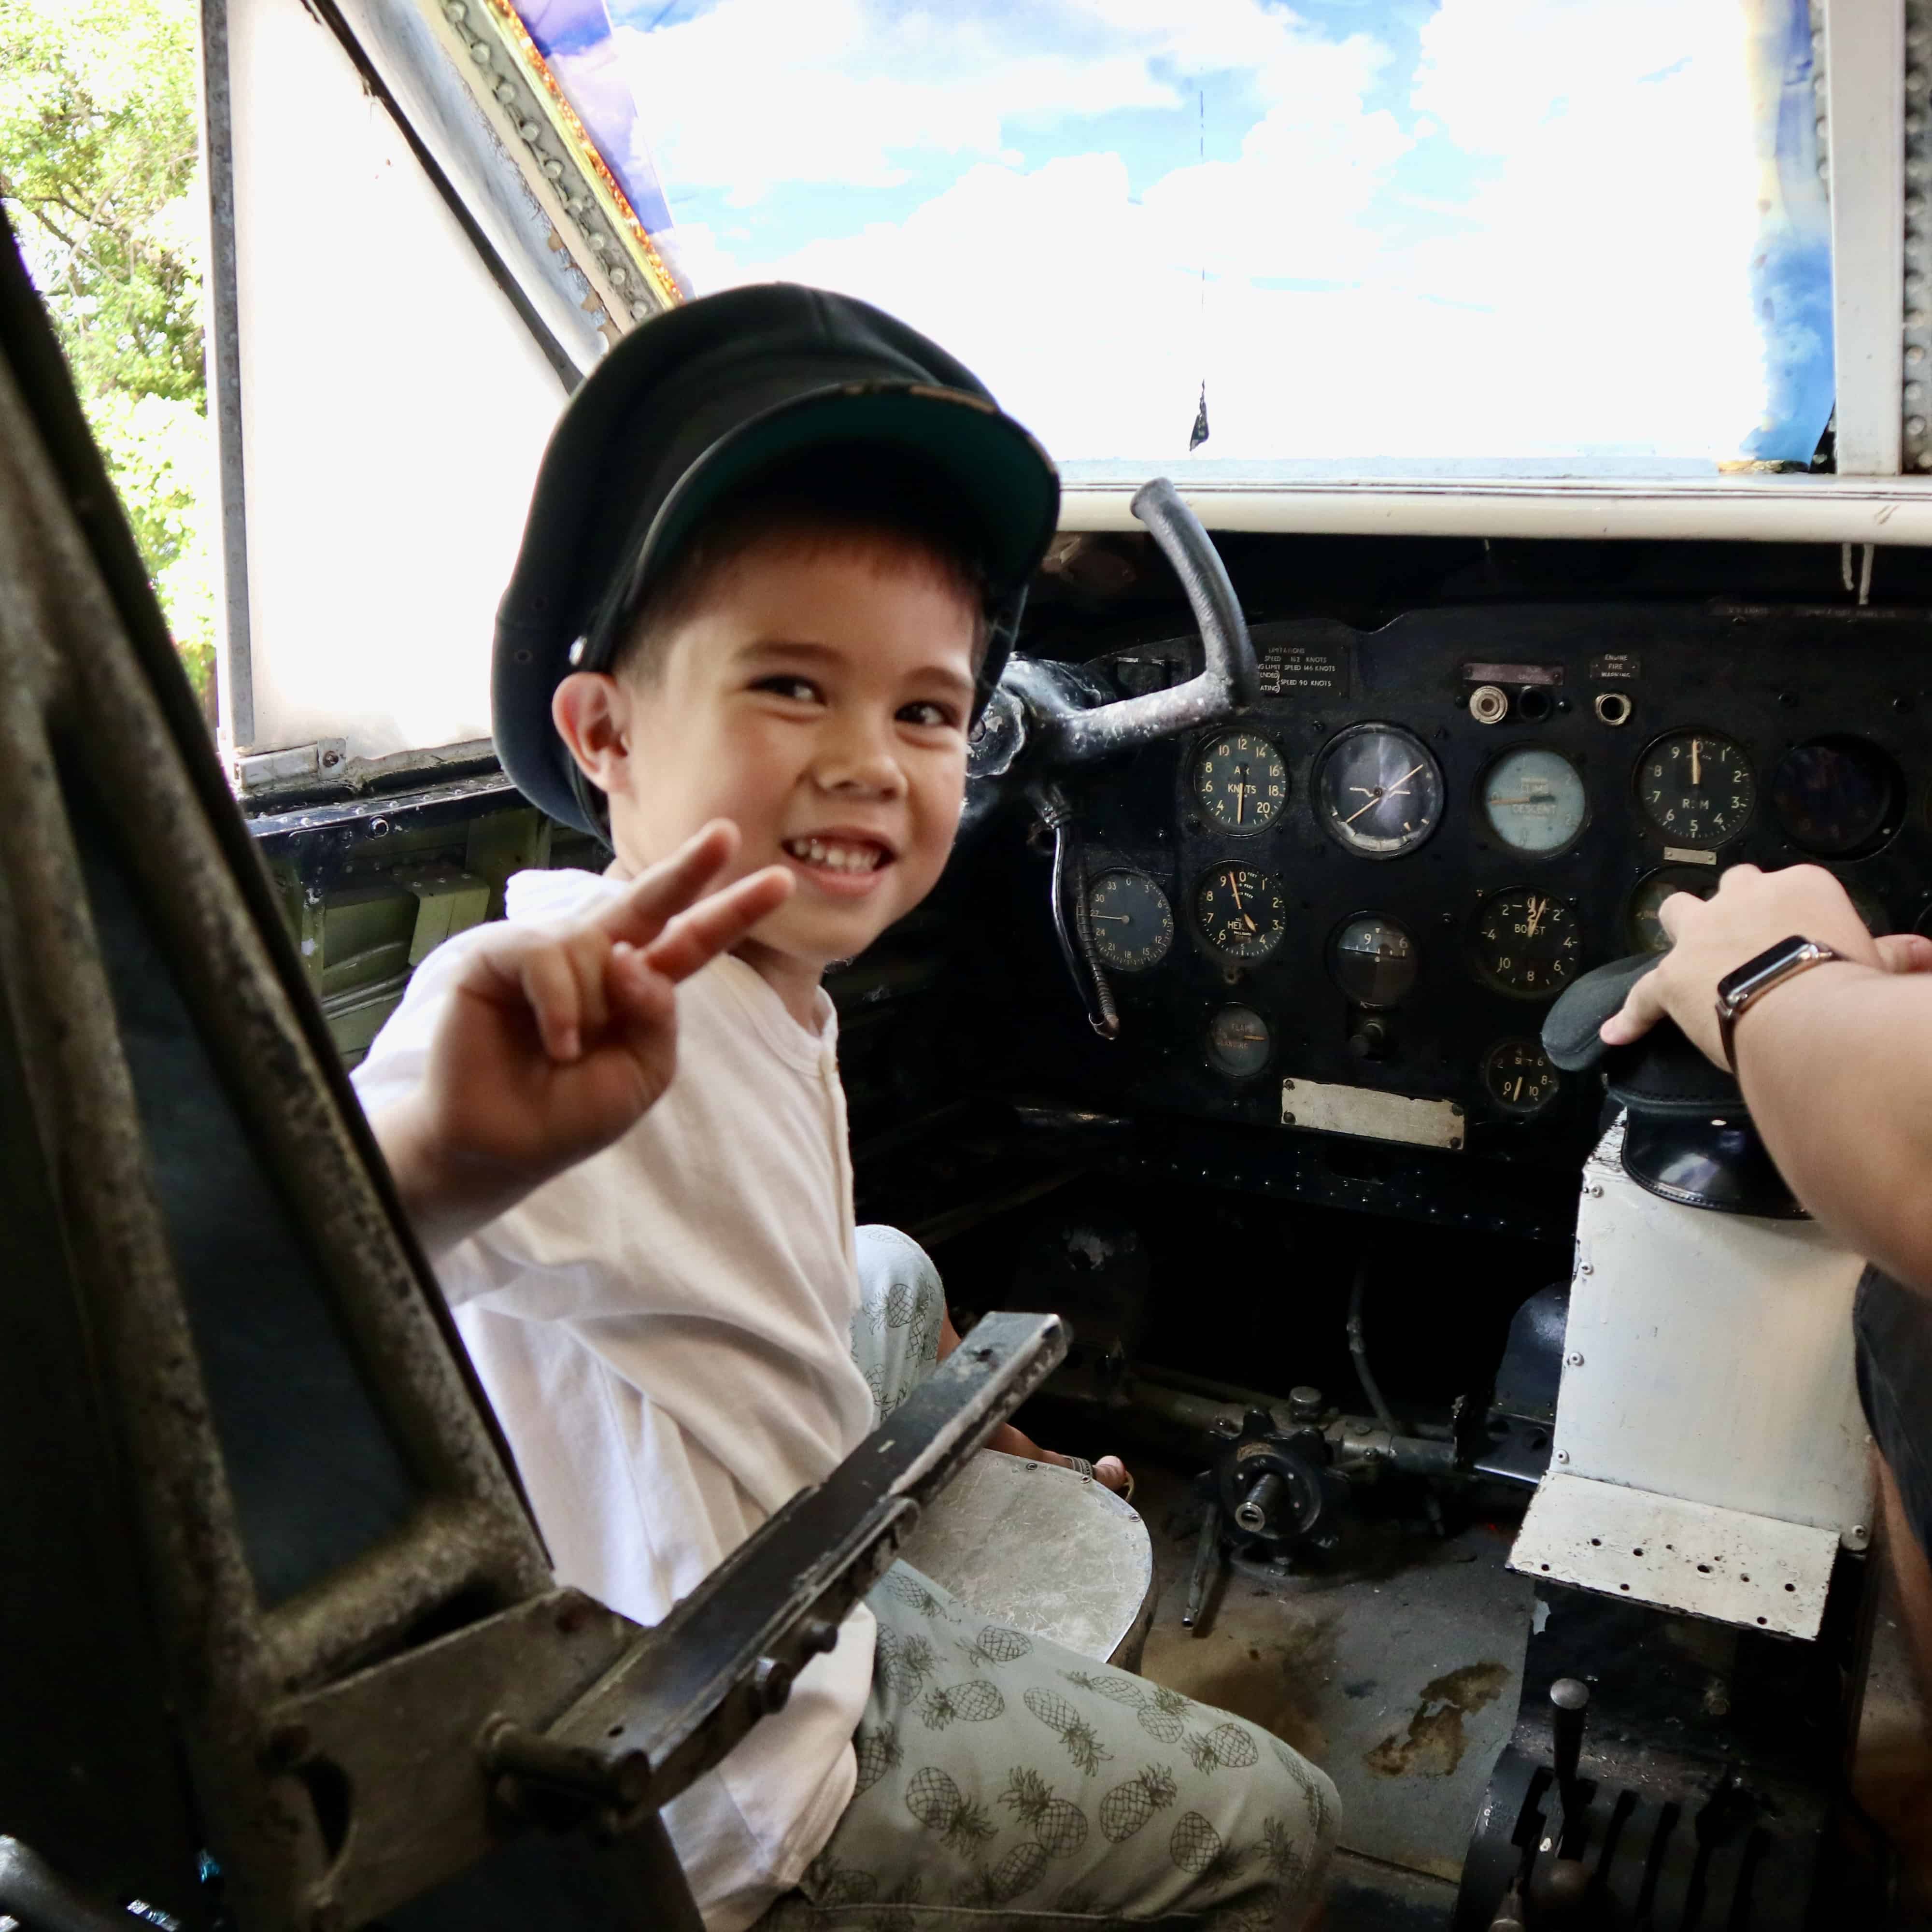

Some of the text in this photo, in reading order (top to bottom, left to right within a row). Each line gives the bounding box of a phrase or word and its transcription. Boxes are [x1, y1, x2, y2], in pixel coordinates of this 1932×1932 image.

[1219, 744, 1230, 756] 10
[1237, 738, 1248, 750] 12
[1256, 747, 1266, 758] 14
[1671, 746, 1680, 759] 9
[1205, 761, 1213, 773] 8
[1269, 765, 1280, 777] 16
[1653, 765, 1662, 777] 8
[1733, 770, 1742, 782] 2
[1205, 781, 1213, 793] 6
[1268, 785, 1279, 796] 18
[1652, 790, 1661, 803] 7
[1731, 796, 1740, 809] 3
[1216, 799, 1224, 811] 4
[1256, 801, 1271, 813] 20
[1666, 809, 1675, 822] 6
[1713, 812, 1724, 825] 4
[1690, 819, 1699, 832] 5
[1125, 877, 1132, 886] 0
[1220, 875, 1227, 887] 9
[1238, 871, 1247, 882] 0
[1107, 881, 1117, 890] 33
[1094, 894, 1106, 903] 30
[1206, 890, 1214, 902] 8
[1157, 899, 1163, 908] 6
[1272, 896, 1279, 909] 2
[1502, 904, 1509, 916] 2
[1553, 909, 1561, 921] 2
[1162, 919, 1167, 927] 9
[1207, 912, 1214, 923] 7
[1272, 919, 1279, 931] 3
[1514, 923, 1546, 935] BOST
[1095, 927, 1106, 936] 24
[1219, 929, 1227, 941] 6
[1487, 928, 1496, 940] 4
[1155, 936, 1162, 944] 12
[1259, 934, 1266, 945] 4
[1364, 933, 1372, 945] 9
[1399, 936, 1408, 949] 6
[1563, 937, 1573, 948] 4
[1108, 942, 1116, 952] 21
[1142, 947, 1150, 956] 15
[1124, 950, 1132, 959] 18
[1499, 957, 1511, 969] 10
[1553, 960, 1562, 971] 6
[1527, 970, 1535, 981] 8
[1541, 1075, 1548, 1085] 8
[1504, 1081, 1512, 1092] 0
[1529, 1085, 1539, 1096] 10
